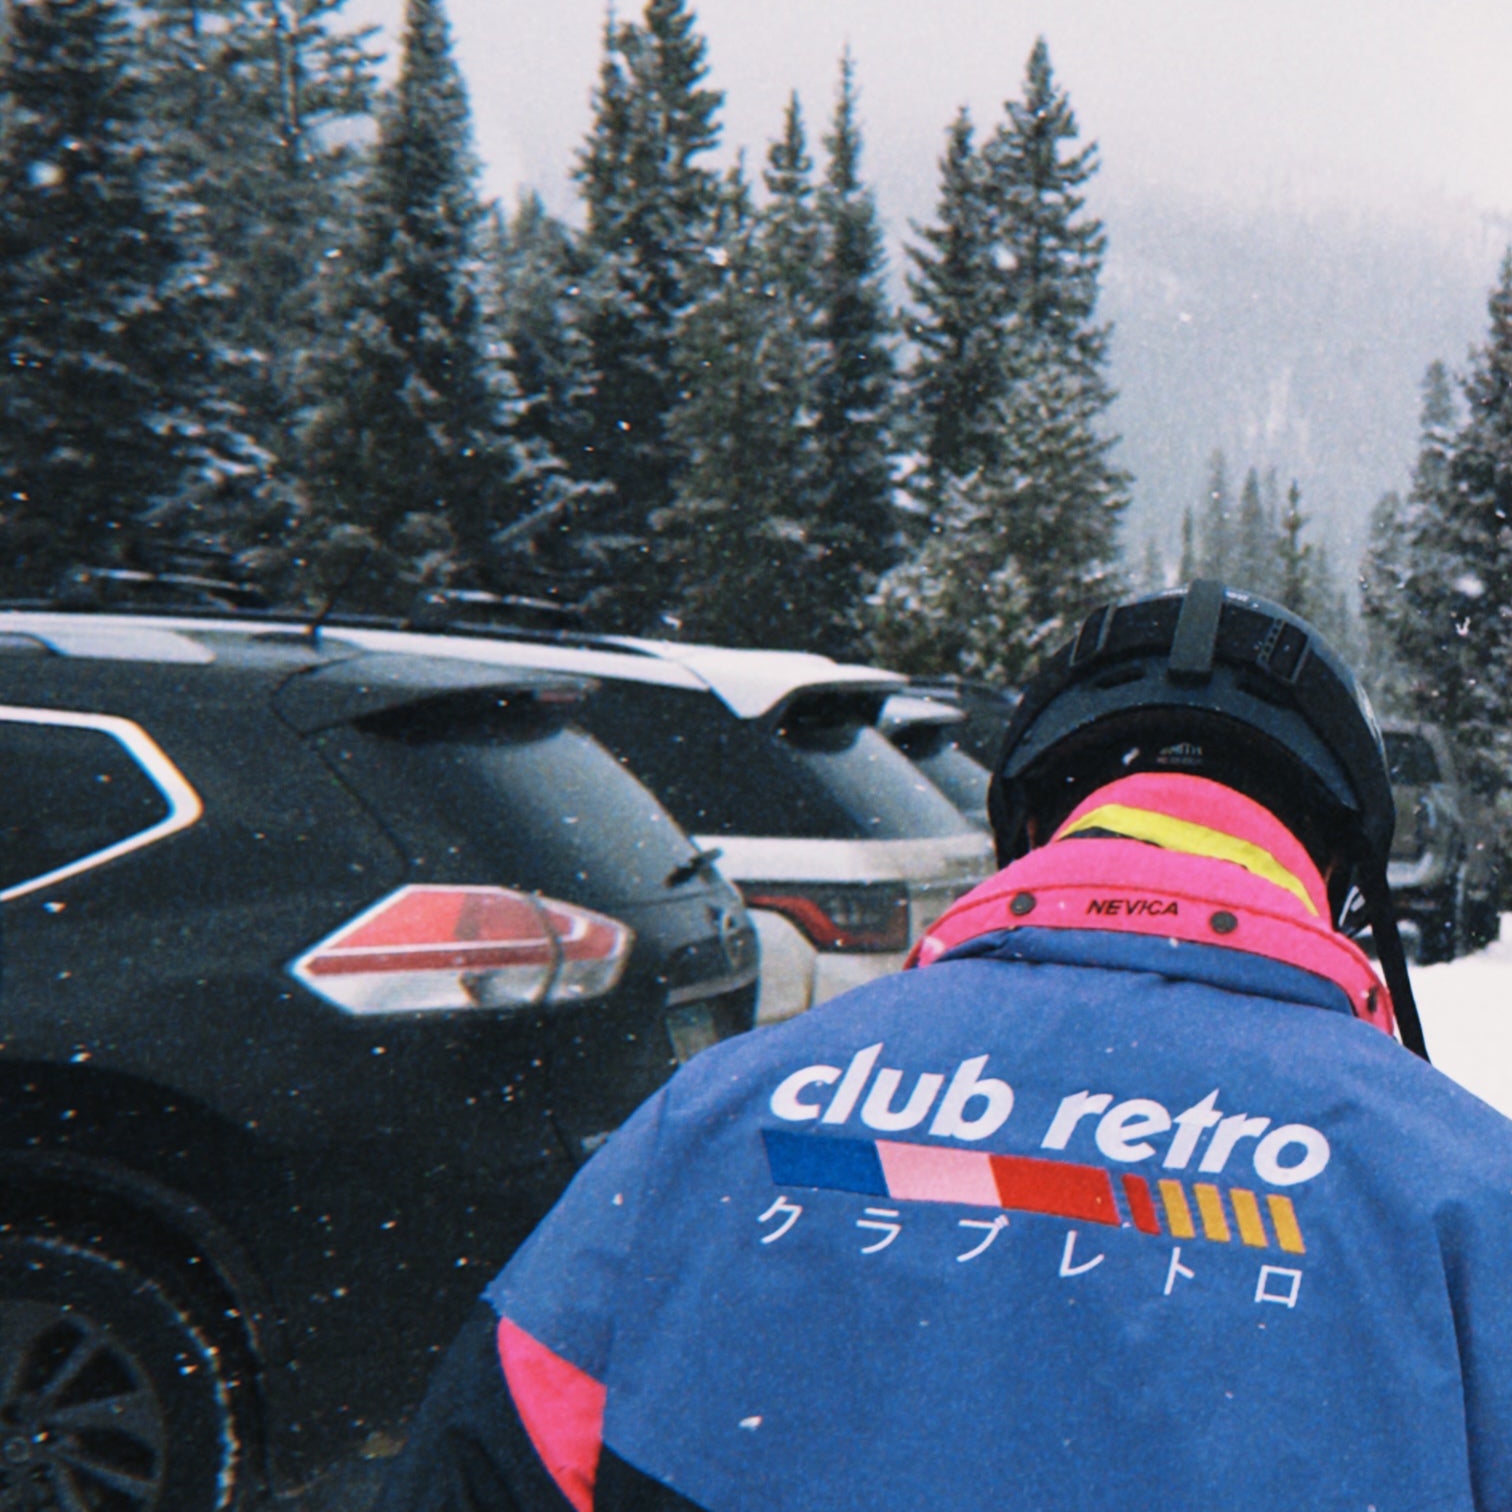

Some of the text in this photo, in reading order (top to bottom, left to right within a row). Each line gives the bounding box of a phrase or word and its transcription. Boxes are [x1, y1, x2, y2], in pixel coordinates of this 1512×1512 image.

[1085, 899, 1179, 916] NEVICA
[769, 1042, 1331, 1186] club retro
[758, 1195, 1303, 1308] クラブレトロ
